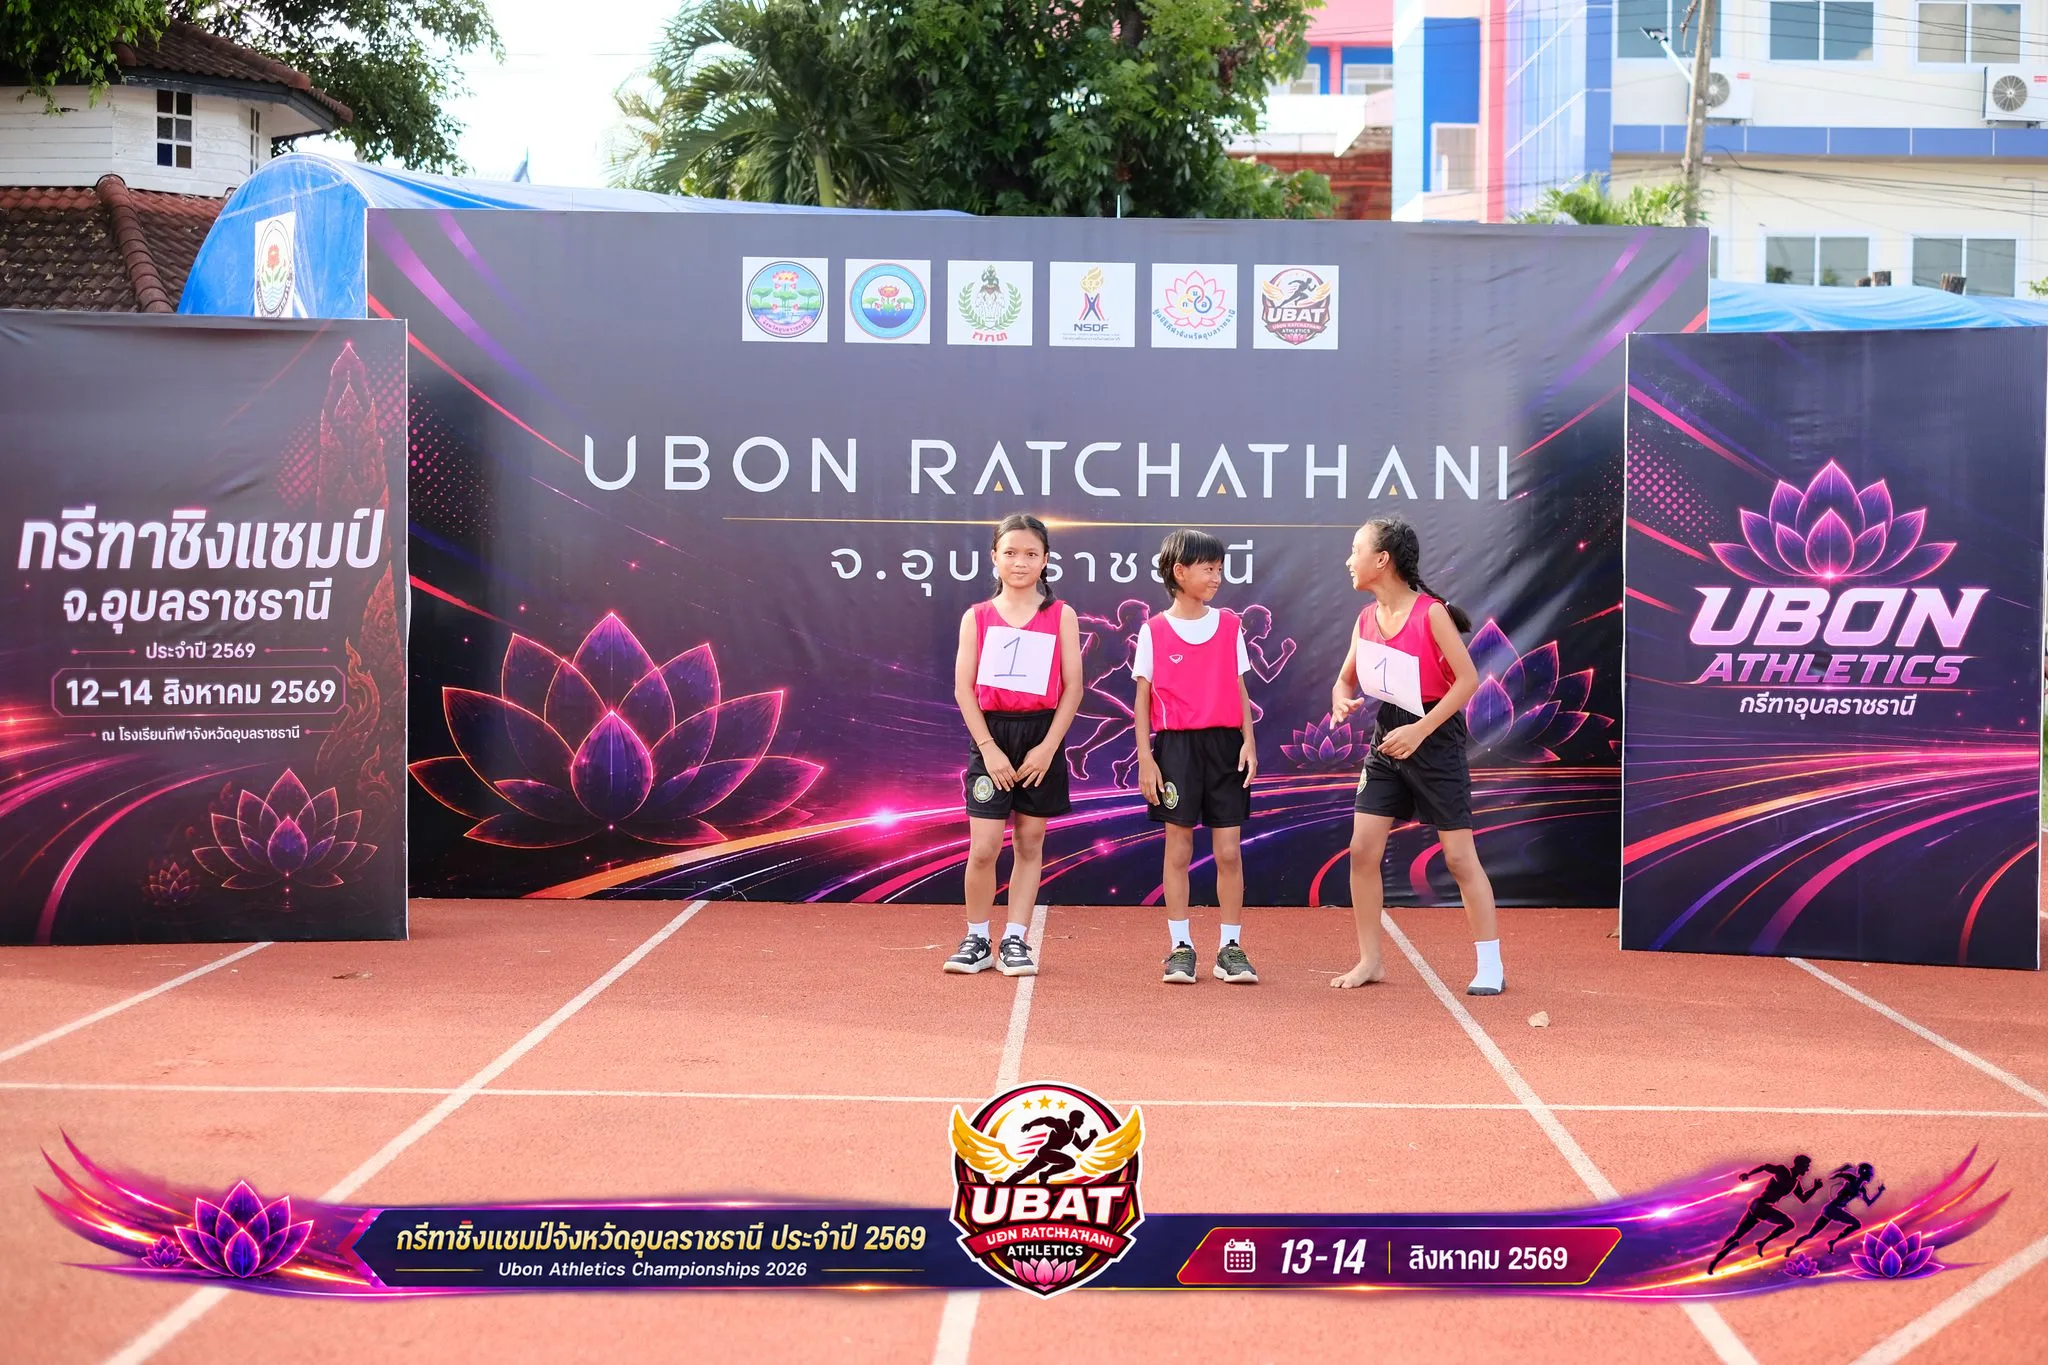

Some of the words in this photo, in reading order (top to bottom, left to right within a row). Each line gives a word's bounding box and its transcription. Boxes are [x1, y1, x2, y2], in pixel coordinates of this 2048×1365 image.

[1073, 323, 1109, 332] NSDF
[1267, 307, 1326, 323] UBAT
[584, 434, 857, 493] UBON
[910, 439, 1508, 500] RATCHATHANI
[17, 505, 386, 569] กรีฑาชิงแชมป์
[63, 577, 333, 635] จ.อุบลราชธานี
[1689, 586, 1990, 648] UBON
[145, 641, 207, 660] ประจำปี
[211, 642, 257, 659] 2569
[993, 635, 1027, 678] 1
[1374, 656, 1395, 696] 1
[1692, 652, 1972, 685] ATHLETICS
[162, 678, 262, 705] สิงหาคม
[270, 679, 337, 704] 2569
[1738, 691, 1918, 720] กรีฑาอุบลราชธานี
[101, 730, 116, 742] ณ
[118, 725, 301, 743] โรงเรียนกีฬาจังหวัดอุบลราชธานี
